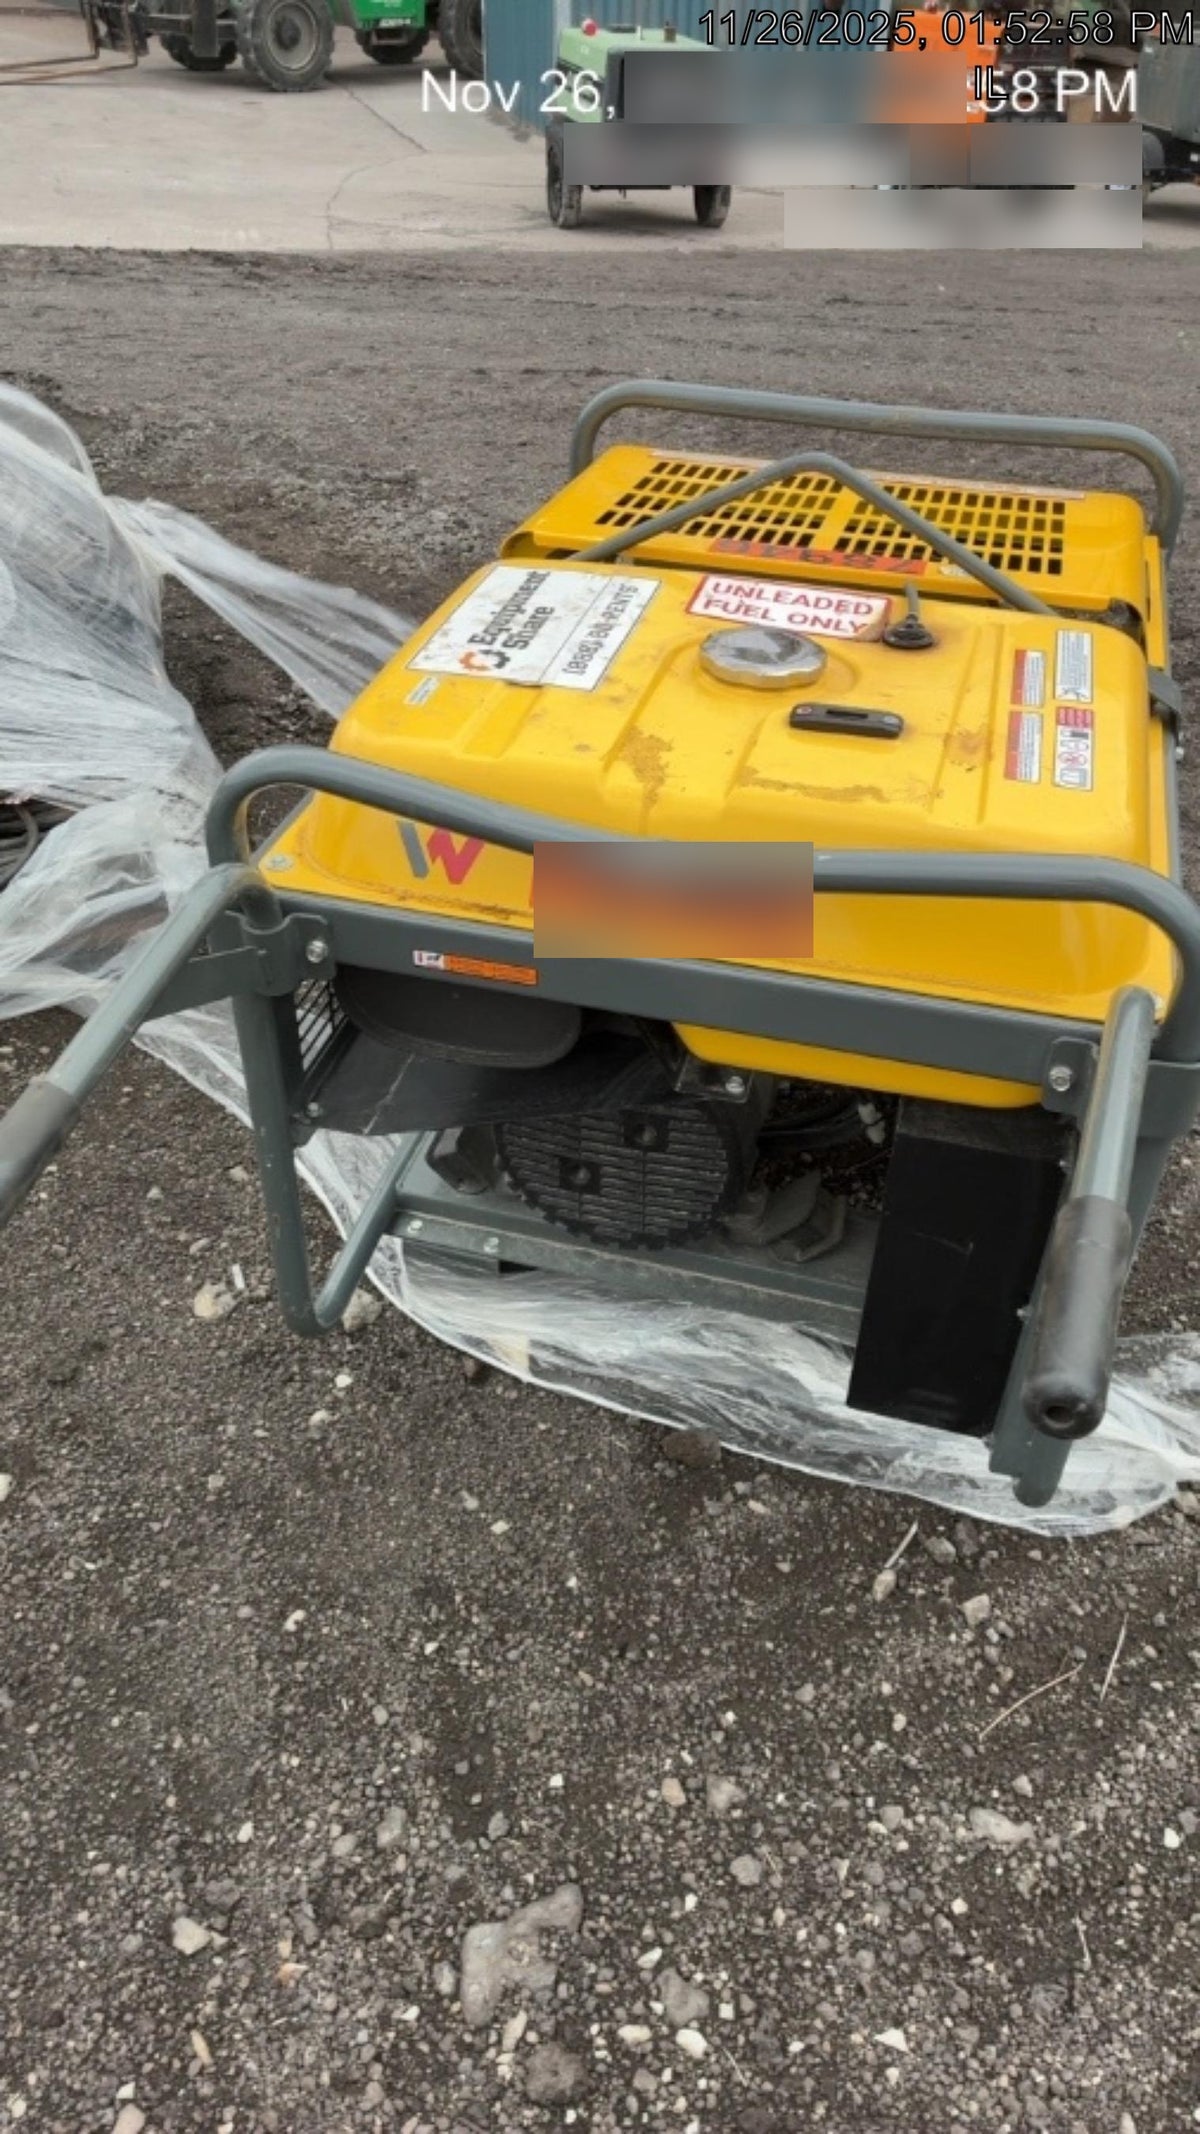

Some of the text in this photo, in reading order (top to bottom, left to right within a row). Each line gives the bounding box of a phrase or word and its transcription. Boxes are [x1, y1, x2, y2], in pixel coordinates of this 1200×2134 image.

[468, 570, 551, 647] Equipment
[703, 598, 869, 635] FUEL ONLY
[712, 581, 874, 617] UNLEADED
[502, 605, 555, 651] Share
